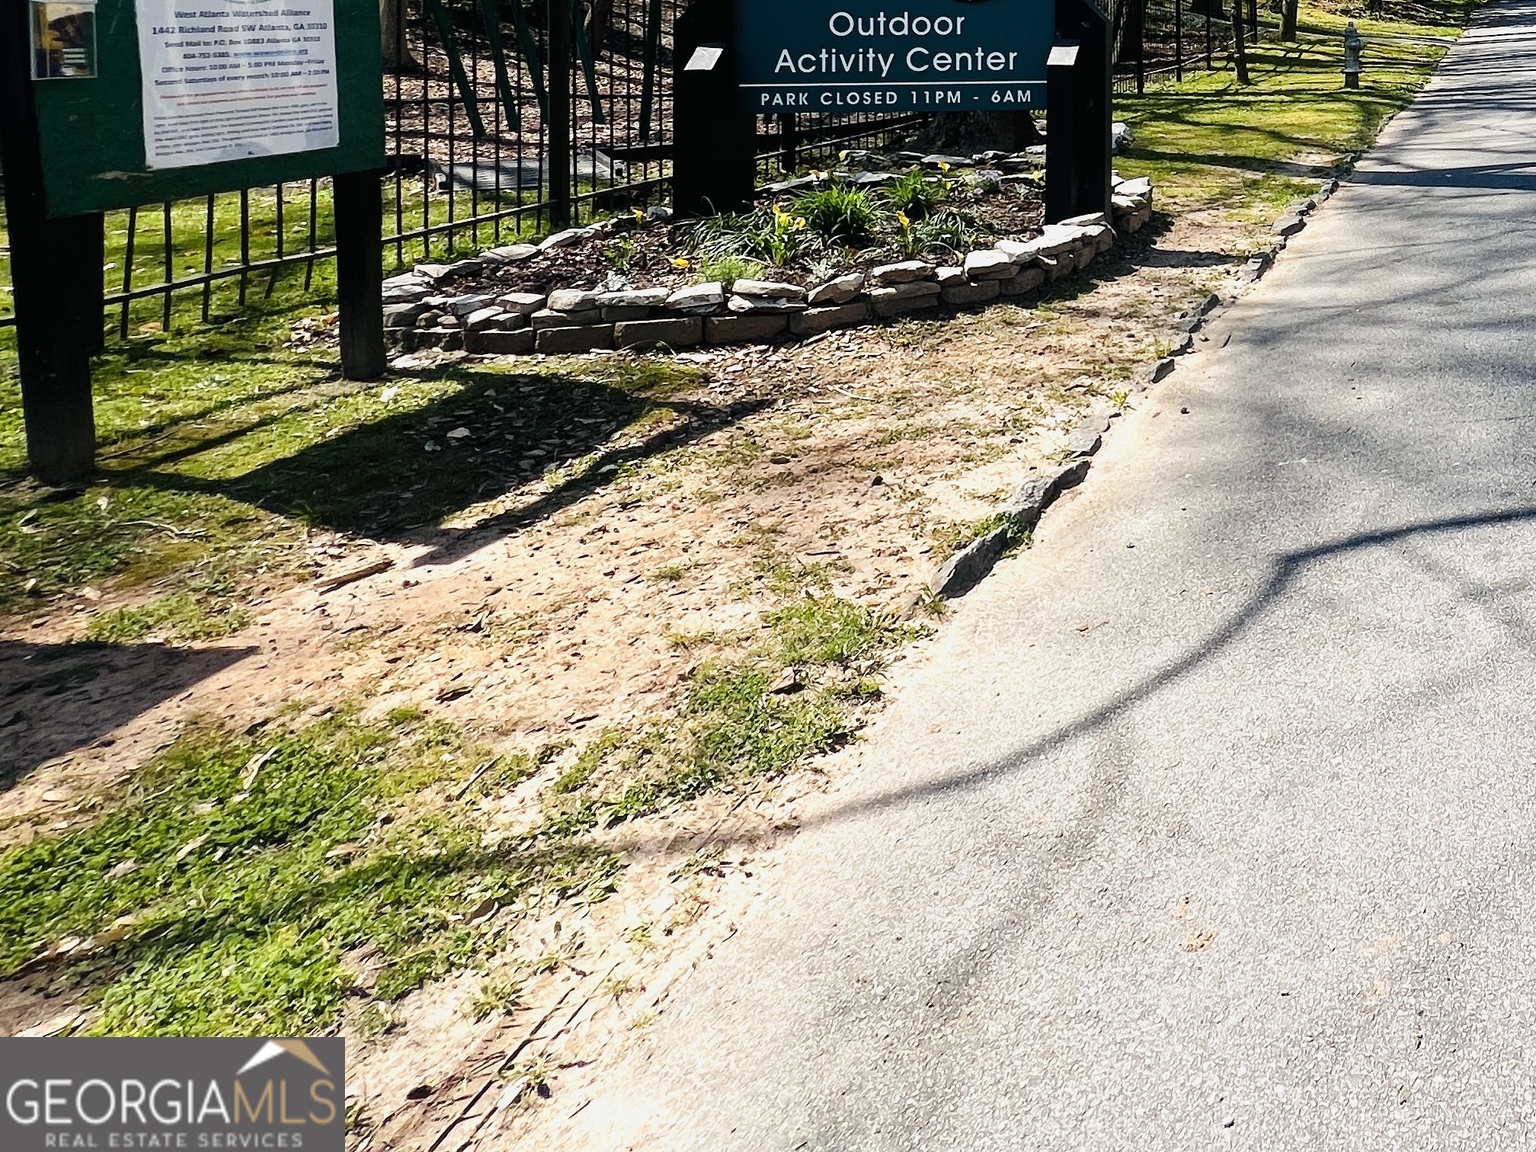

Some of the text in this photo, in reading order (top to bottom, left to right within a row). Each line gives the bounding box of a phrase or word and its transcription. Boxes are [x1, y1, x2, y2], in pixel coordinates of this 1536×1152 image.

[199, 10, 230, 18] Atlanta
[232, 9, 278, 18] Watershed
[281, 9, 311, 17] Alliance
[152, 26, 176, 35] 1442
[178, 25, 215, 34] Richland
[217, 25, 239, 33] Road
[241, 24, 256, 32] SW
[829, 11, 965, 37] Outdoor
[774, 46, 1018, 78] Activity Center
[761, 92, 808, 105] PARK
[820, 91, 898, 105] CLOSED
[911, 90, 961, 104] 11PM
[991, 89, 1031, 103] 6AM
